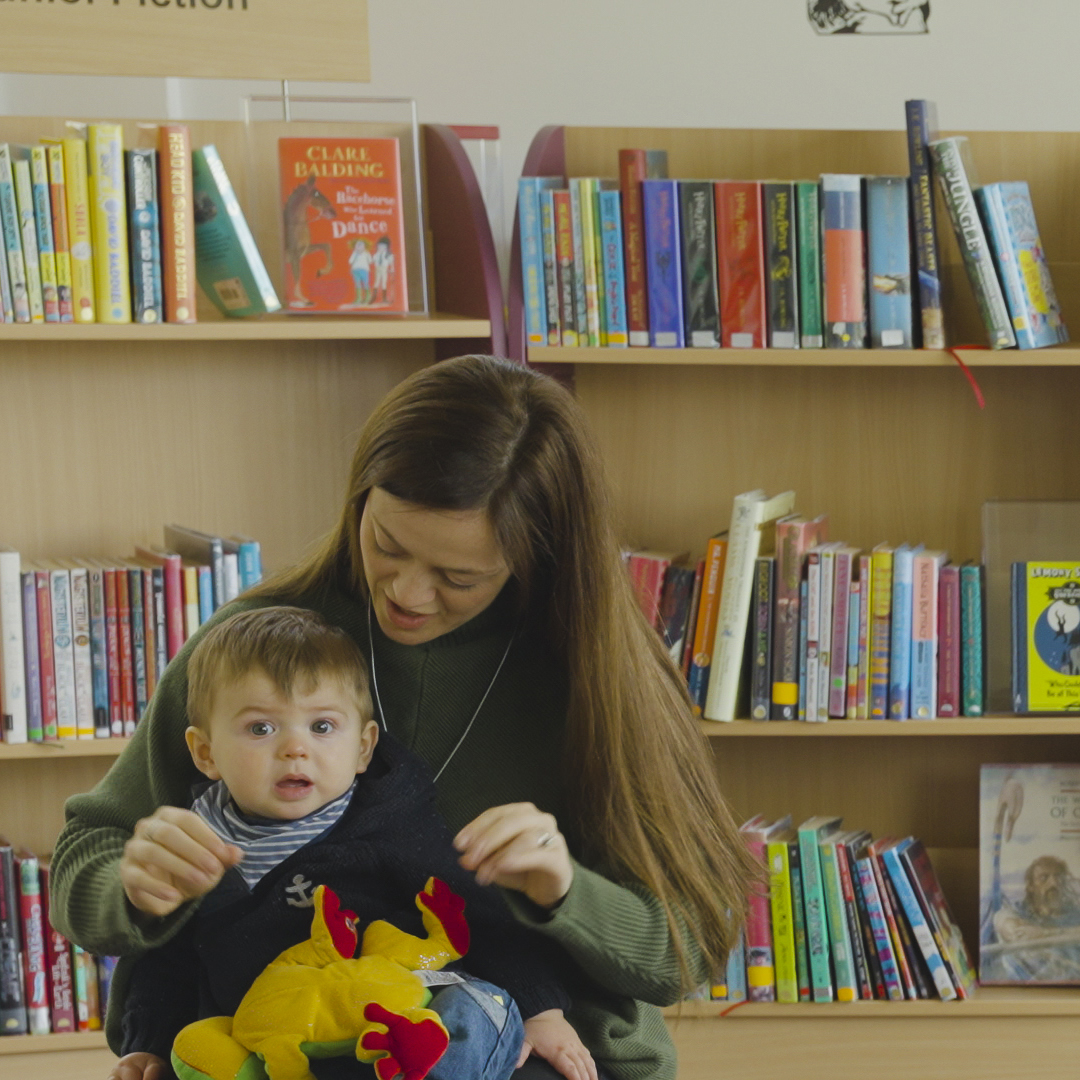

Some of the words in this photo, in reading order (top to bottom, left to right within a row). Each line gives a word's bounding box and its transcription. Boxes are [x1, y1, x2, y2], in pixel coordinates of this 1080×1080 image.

[168, 132, 185, 168] HEAD
[306, 146, 372, 162] CLARE
[294, 162, 384, 178] BALDING
[171, 169, 185, 194] KID
[944, 165, 983, 251] JUNGLE
[331, 219, 388, 239] Dance
[1031, 566, 1073, 579] LEMONY
[1050, 806, 1067, 818] OF
